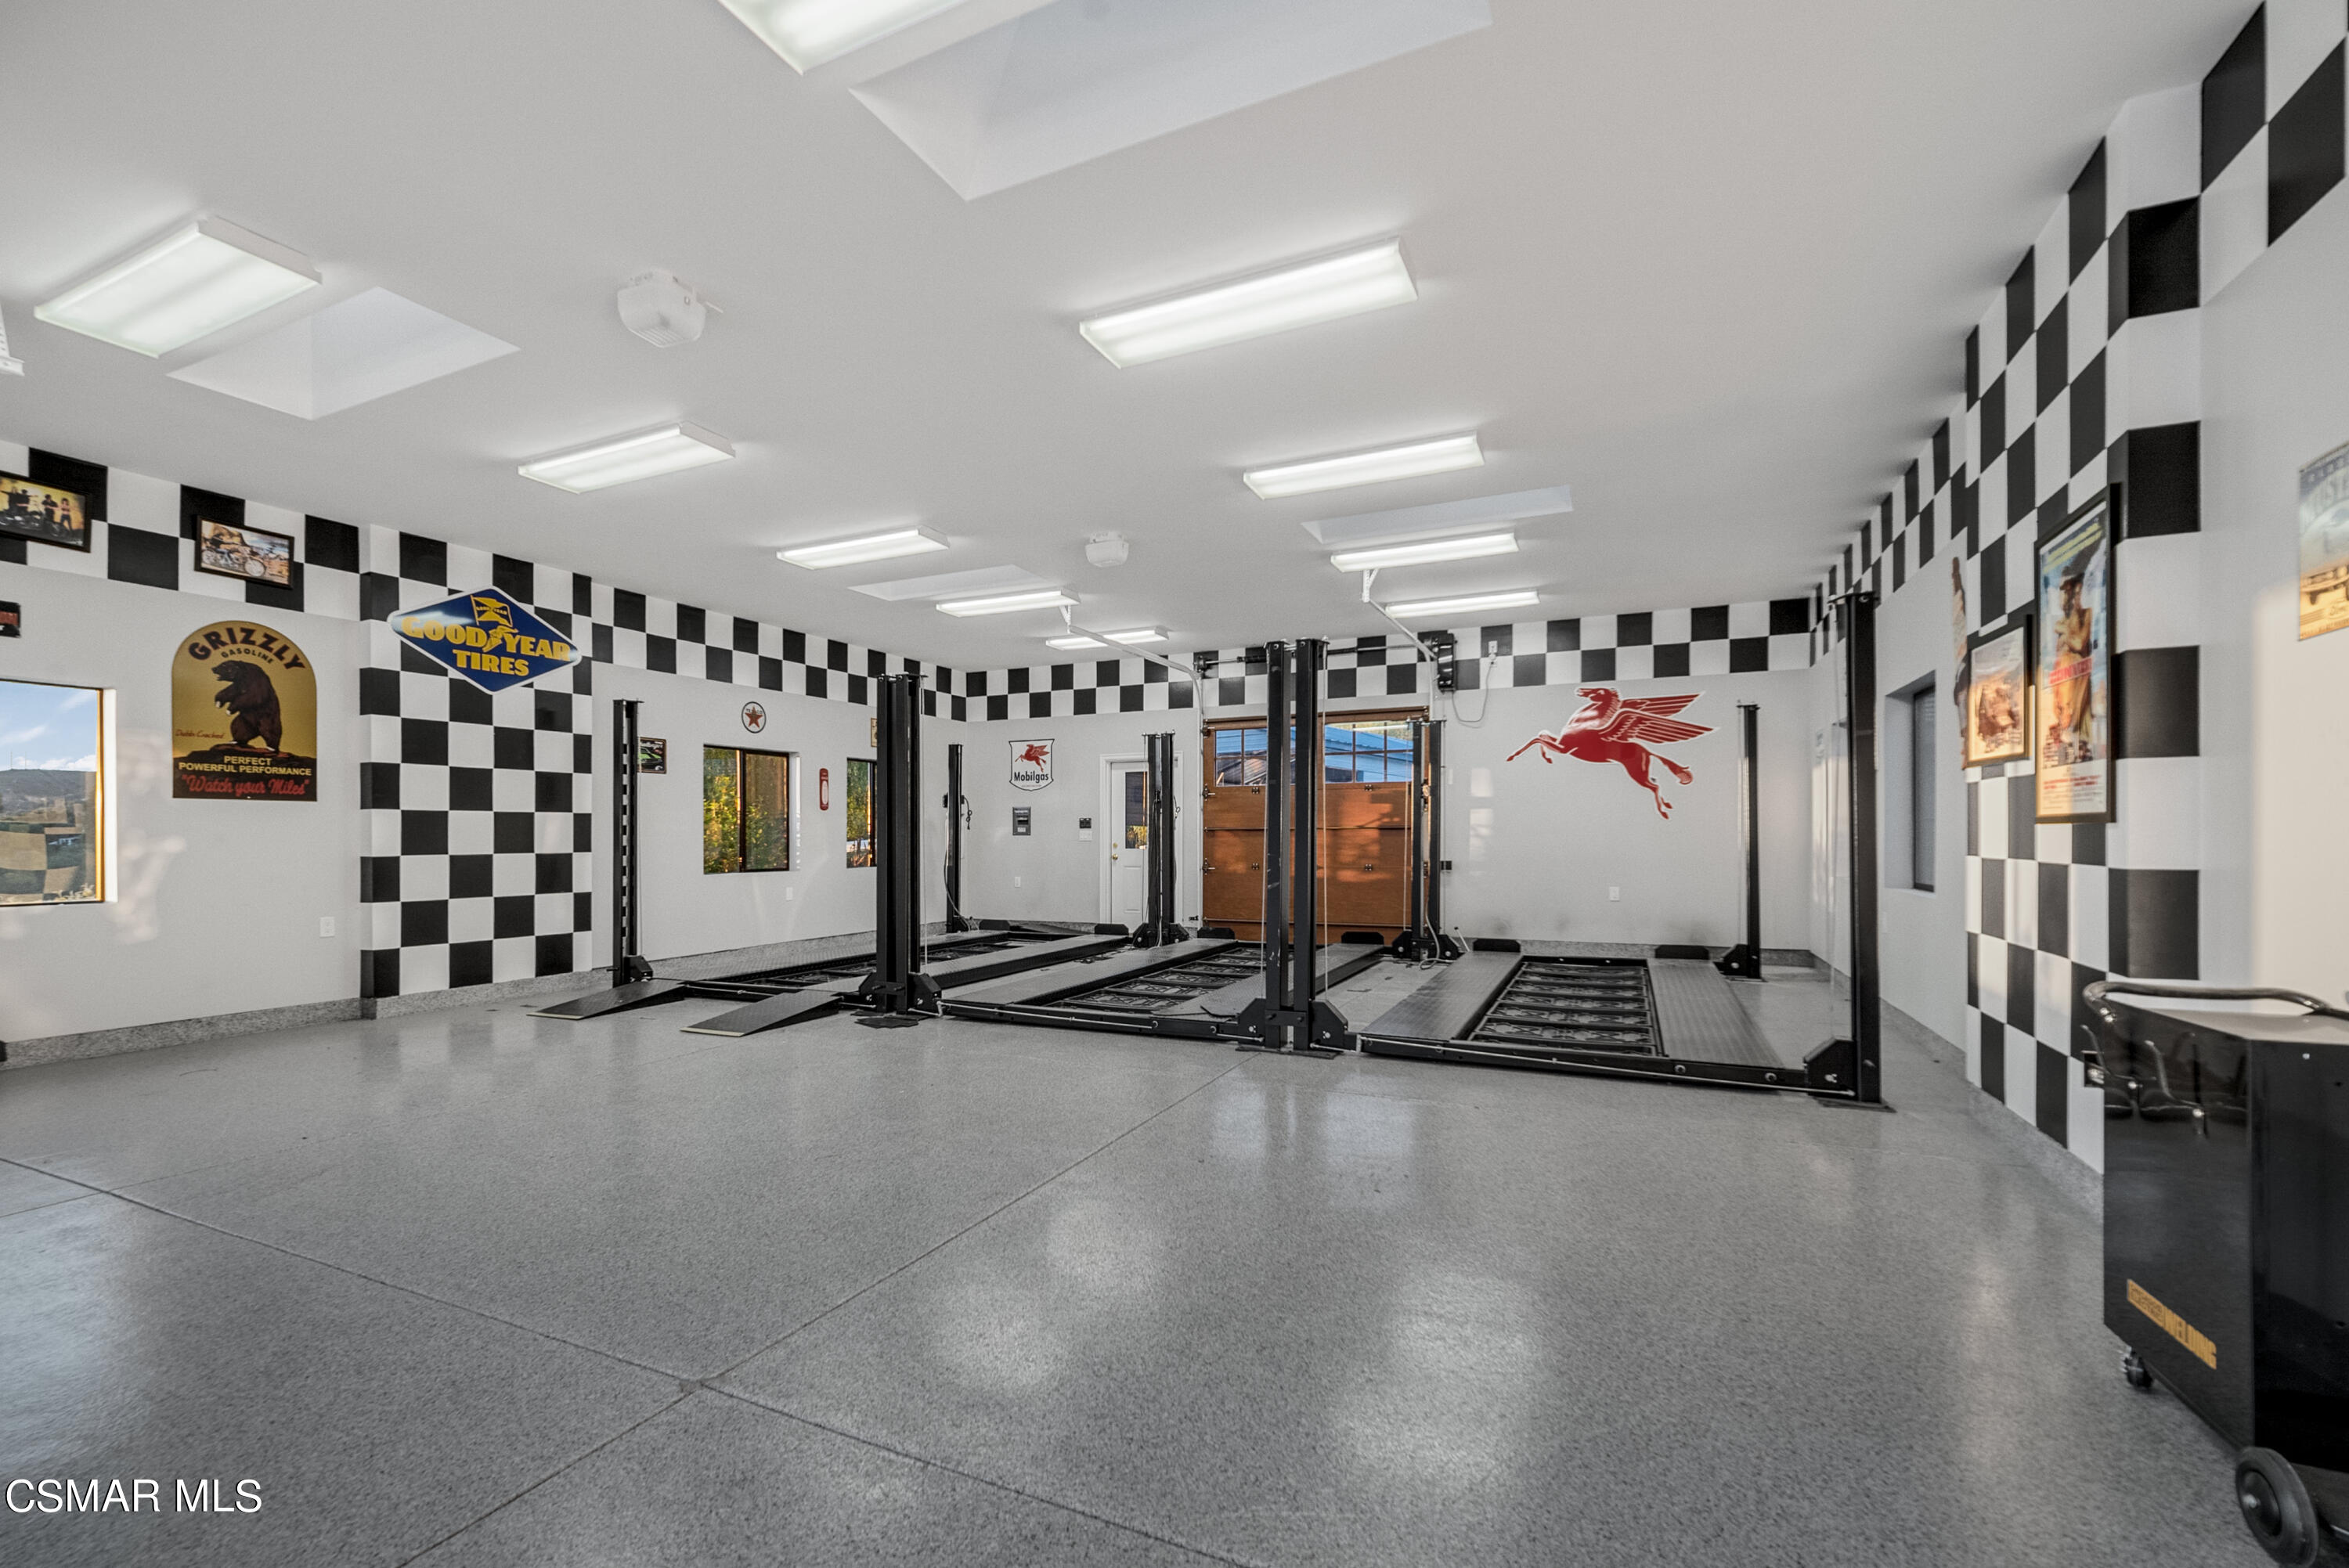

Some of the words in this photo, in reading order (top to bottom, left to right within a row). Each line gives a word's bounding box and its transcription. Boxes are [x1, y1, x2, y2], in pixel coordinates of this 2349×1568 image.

[188, 627, 305, 670] GRIZZLY
[221, 647, 274, 665] GASOLINE
[453, 649, 529, 676] TIRES
[224, 755, 272, 766] PERFECT
[179, 762, 237, 773] POWERFUL
[239, 766, 312, 777] PERFORMANCE
[1014, 770, 1049, 784] Mobilgas
[235, 781, 266, 797] your
